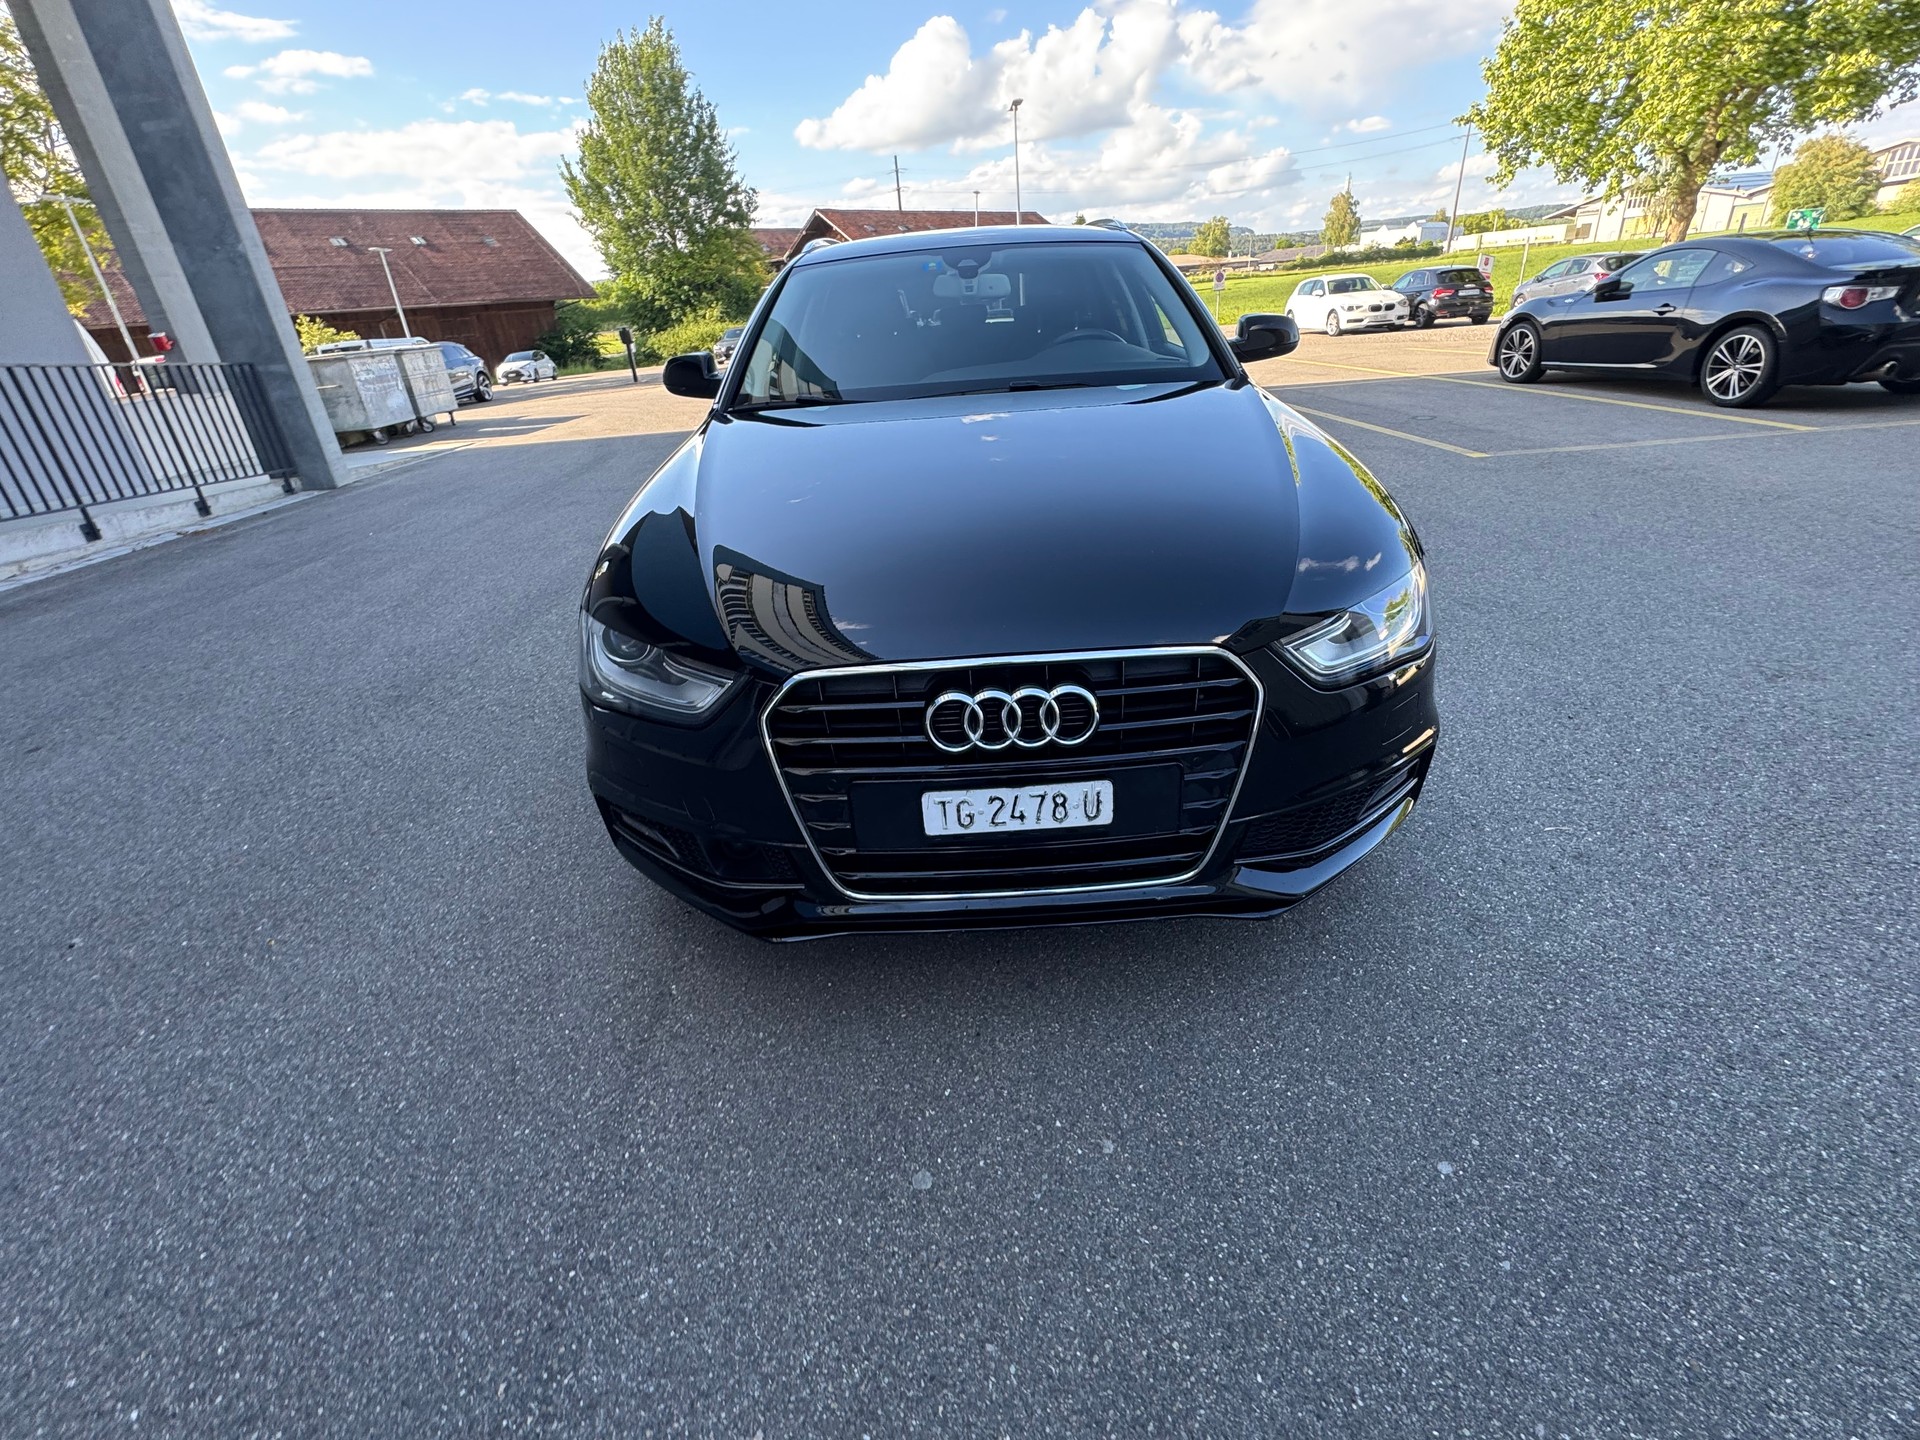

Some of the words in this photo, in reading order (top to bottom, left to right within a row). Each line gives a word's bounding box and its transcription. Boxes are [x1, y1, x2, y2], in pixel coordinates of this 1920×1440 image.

[934, 797, 975, 829] TG
[988, 791, 1068, 827] 2478
[1083, 788, 1102, 821] U
